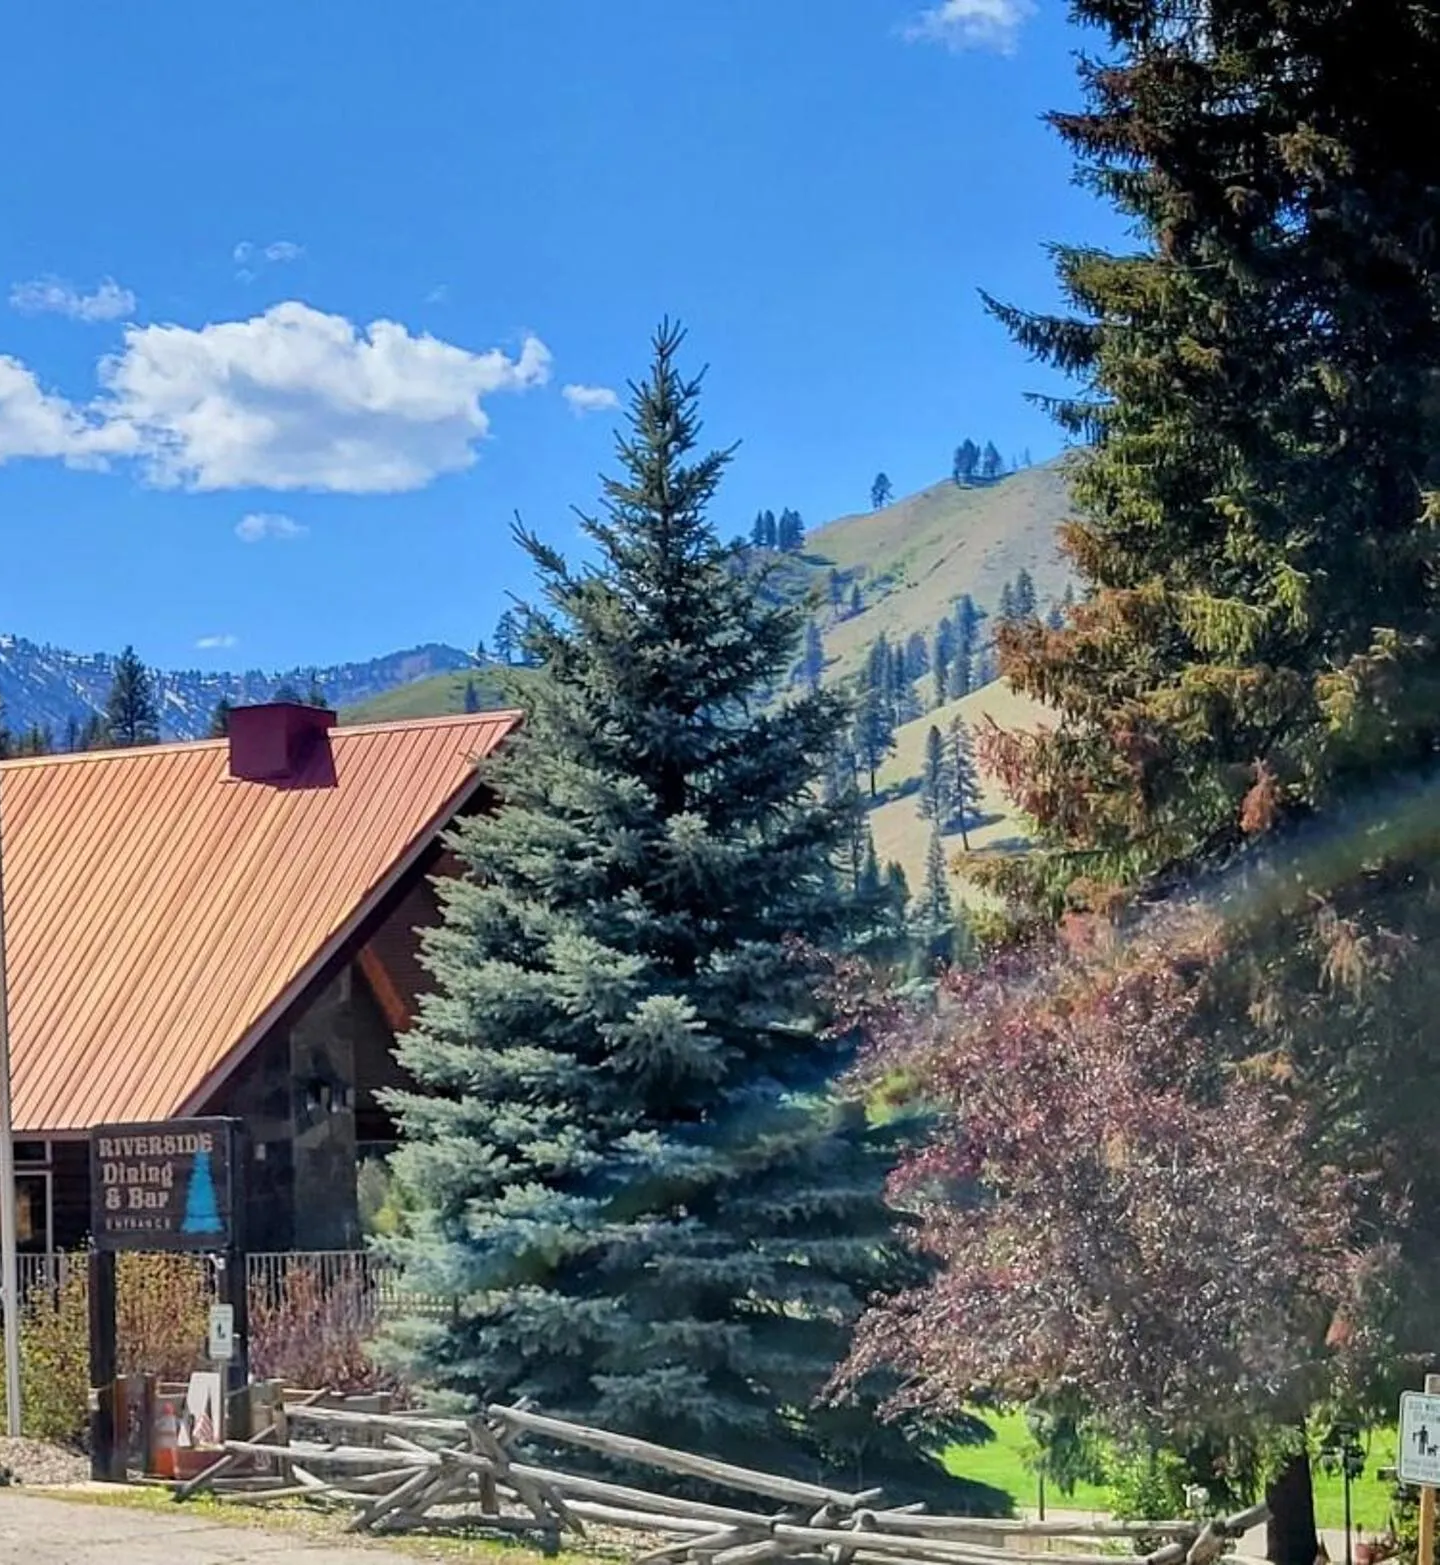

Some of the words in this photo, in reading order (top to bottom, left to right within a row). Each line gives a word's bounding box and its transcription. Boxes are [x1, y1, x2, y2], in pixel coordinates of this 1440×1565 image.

[98, 1132, 214, 1157] RIVERSIDE
[102, 1161, 173, 1188] Dining
[105, 1187, 121, 1210] &
[127, 1187, 170, 1209] Bar
[105, 1217, 171, 1230] ENTRANCE
